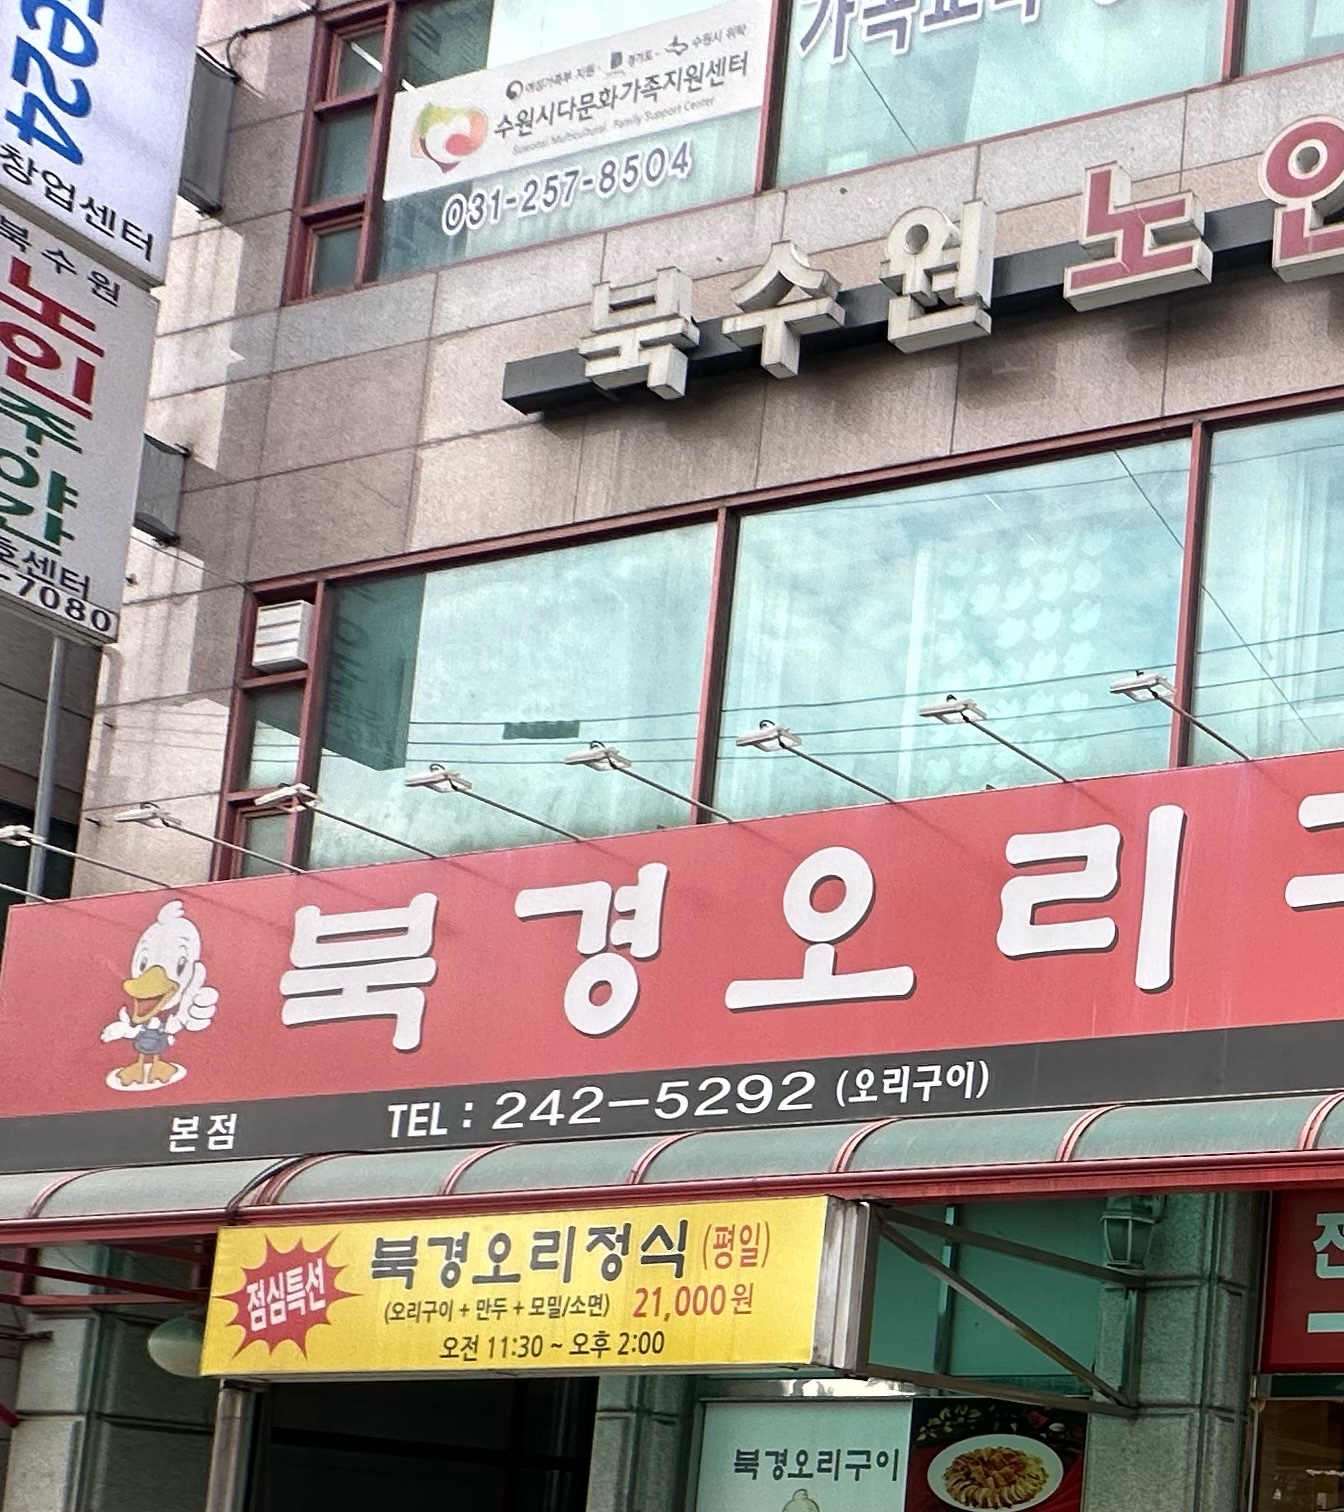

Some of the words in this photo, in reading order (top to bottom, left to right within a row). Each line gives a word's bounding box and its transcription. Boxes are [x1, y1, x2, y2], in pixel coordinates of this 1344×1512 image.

[493, 51, 748, 139] 수원시다문화가족지원센터
[443, 140, 691, 234] 031-257-8504
[579, 199, 996, 399] 북수원
[0, 256, 105, 420] 노인
[834, 1059, 991, 1108] (오리구이)
[167, 1112, 239, 1155] 본점
[369, 1218, 690, 1290] 북경오리정식
[701, 1221, 771, 1272] (평일)
[245, 1255, 327, 1333] 점심특선
[438, 1335, 480, 1362] 오전
[489, 1333, 543, 1359] 11:30
[568, 1332, 611, 1358] 오후
[617, 1330, 666, 1355] 2:00
[733, 1447, 899, 1482] 북경오리구이
